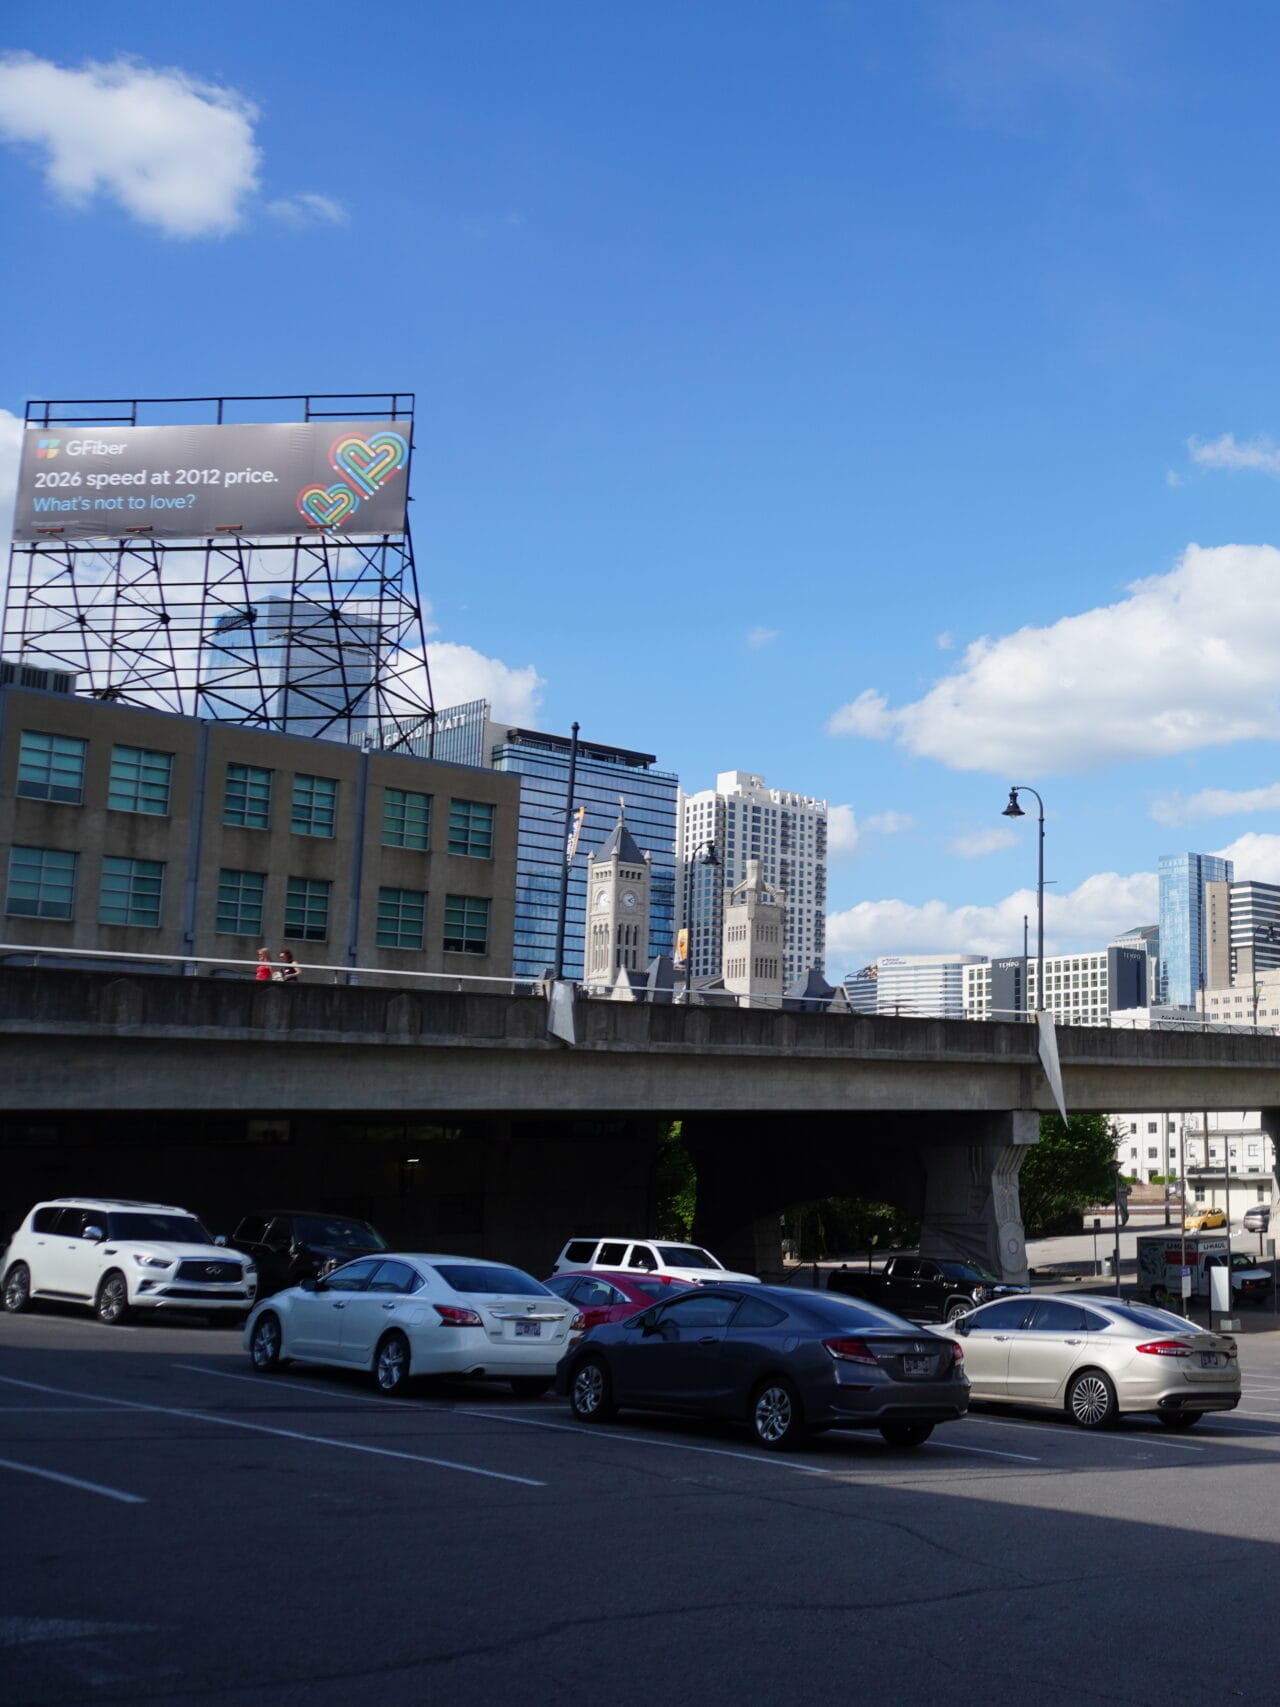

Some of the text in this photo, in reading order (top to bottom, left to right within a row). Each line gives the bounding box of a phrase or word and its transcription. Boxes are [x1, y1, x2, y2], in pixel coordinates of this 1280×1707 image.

[66, 440, 127, 455] GFiber
[35, 467, 279, 489] 2026 speed at 2012 price.
[33, 494, 196, 512] What's not to love?
[999, 960, 1020, 971] TEMPO
